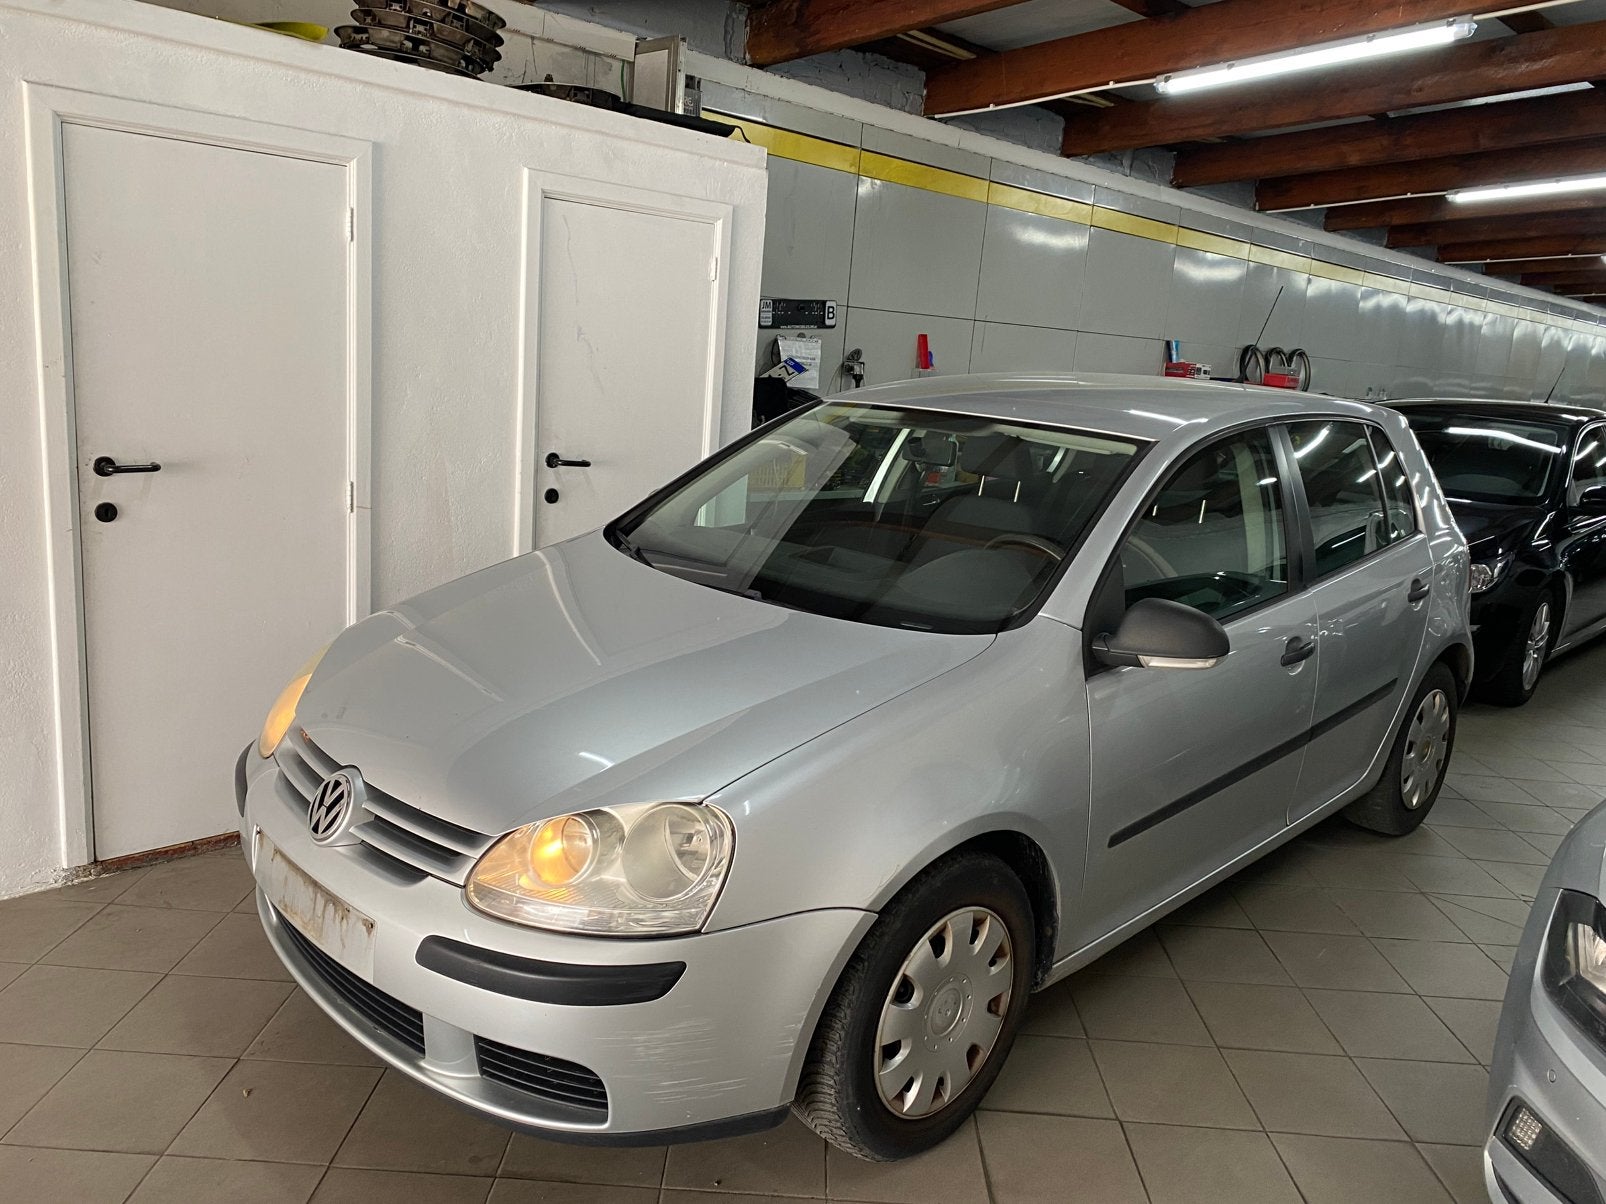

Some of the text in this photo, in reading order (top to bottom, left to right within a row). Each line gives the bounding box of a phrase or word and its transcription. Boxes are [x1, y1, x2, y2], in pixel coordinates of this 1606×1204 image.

[761, 301, 772, 310] JM
[826, 305, 835, 320] B
[308, 775, 350, 841] VW
